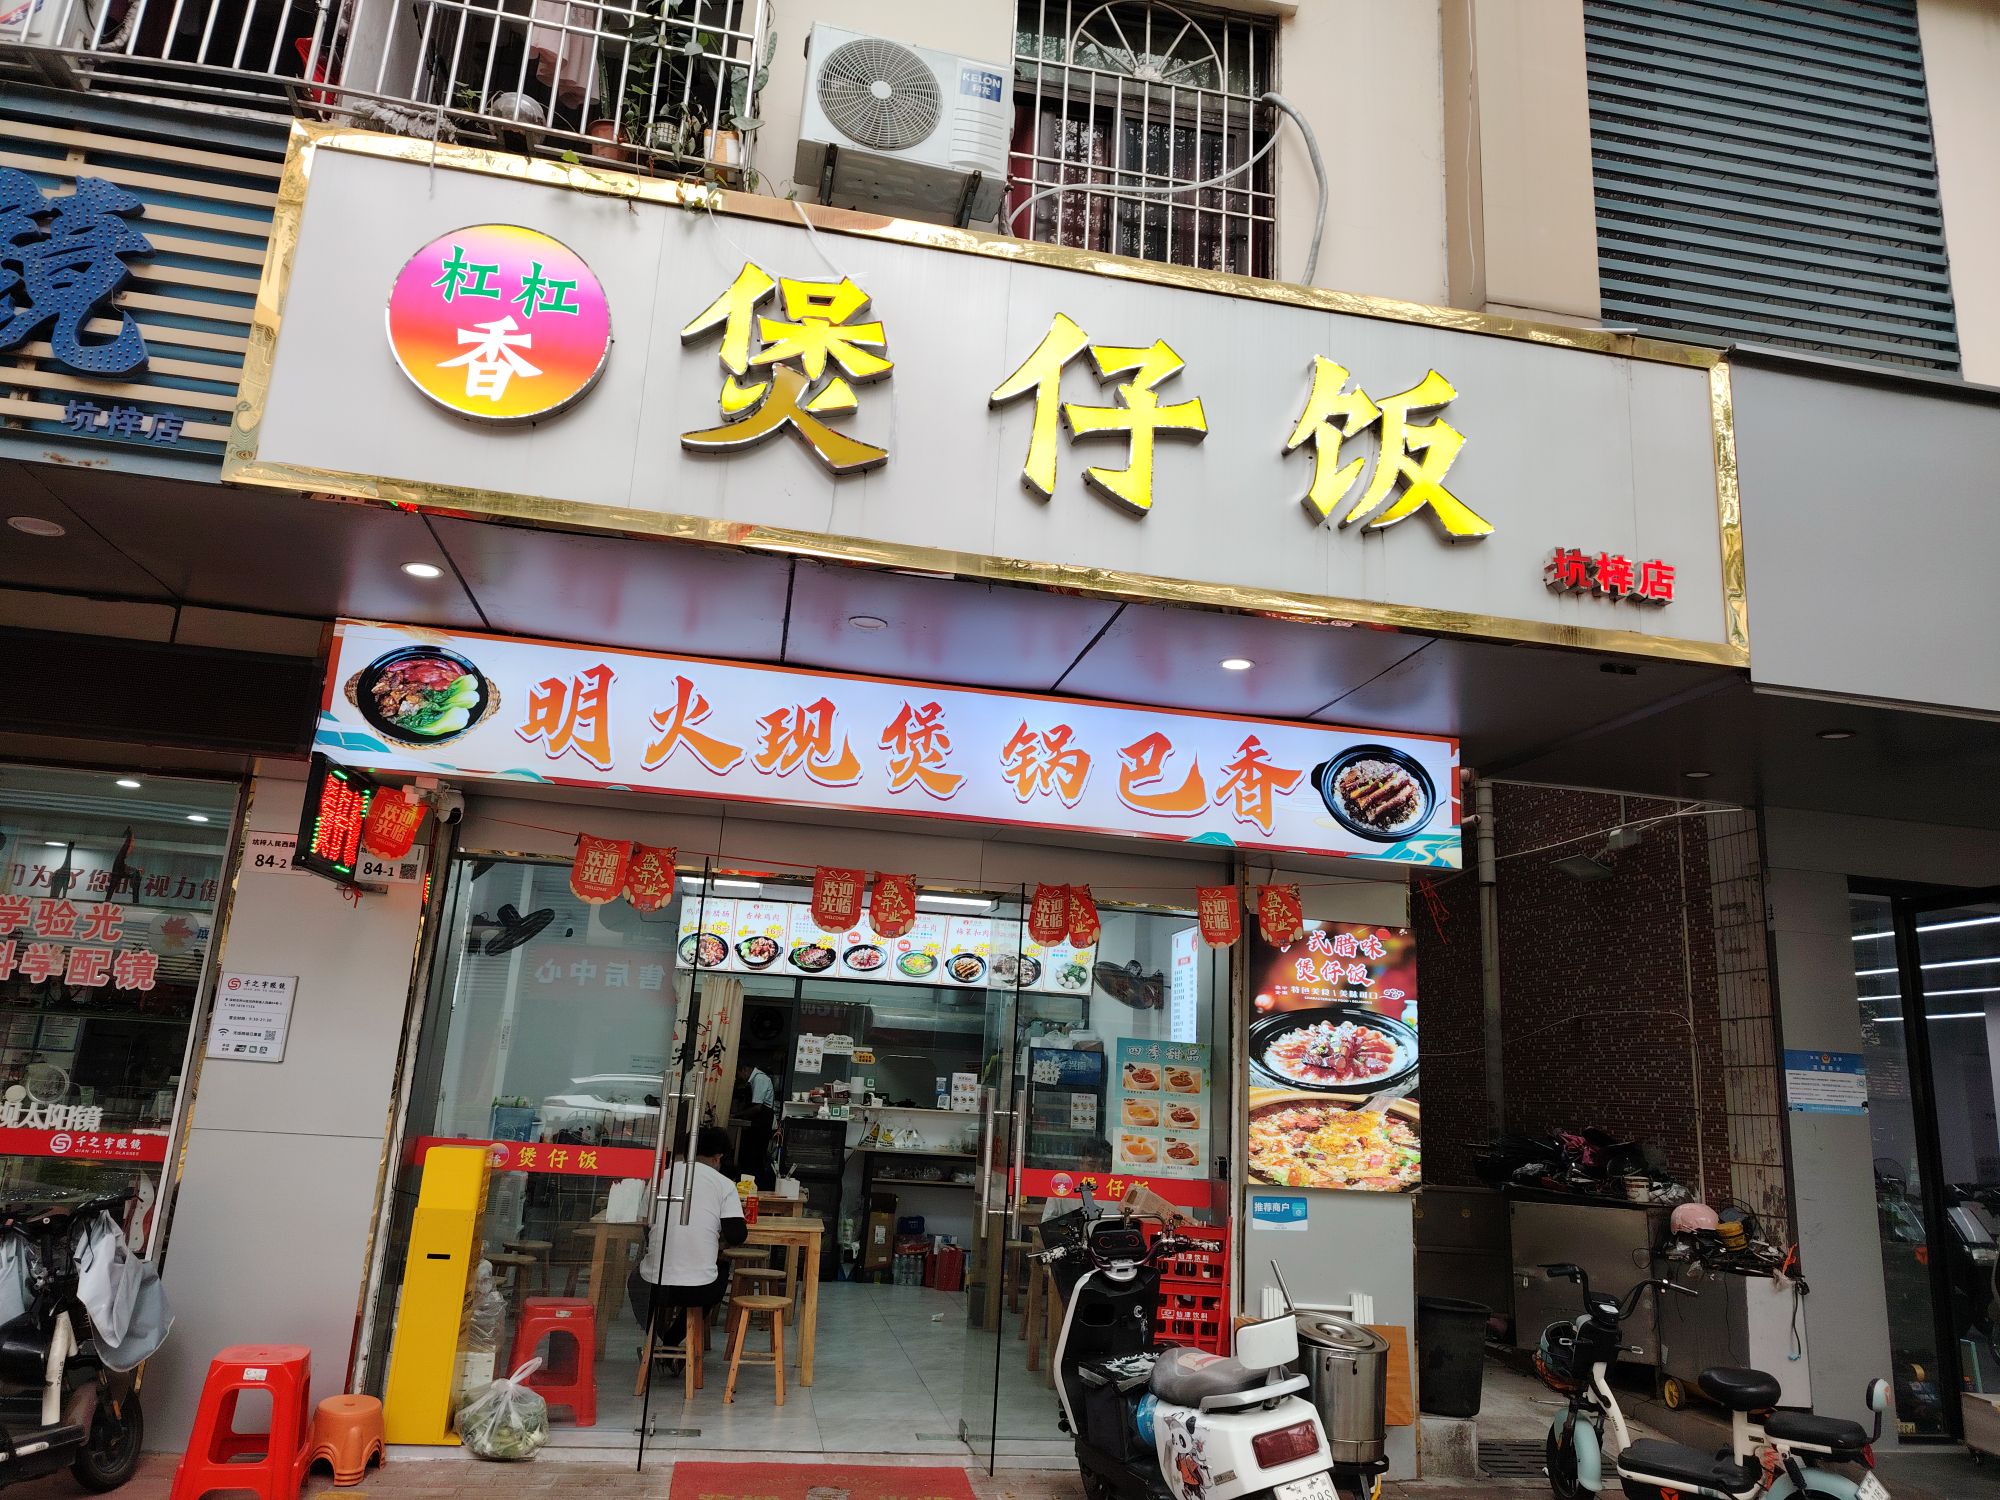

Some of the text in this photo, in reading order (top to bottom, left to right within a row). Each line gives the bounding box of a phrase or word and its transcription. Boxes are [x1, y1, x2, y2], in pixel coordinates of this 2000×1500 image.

[962, 72, 1000, 89] KELON
[431, 245, 579, 318] 杠杠
[436, 315, 543, 401] 香
[680, 262, 1496, 542] 煲仔饭
[61, 399, 184, 444] 坑梓店
[1546, 547, 1677, 605] 坑梓店
[381, 803, 417, 827] 欢迎
[374, 818, 409, 843] 光临
[254, 853, 288, 868] 84-2
[362, 862, 394, 877] 84-1
[585, 851, 619, 869] 欢迎
[581, 866, 616, 885] 光临
[822, 881, 855, 899] 欢迎
[820, 896, 852, 914] 光临
[1037, 898, 1063, 914] 欢迎
[1201, 899, 1228, 916] 欢迎
[1035, 911, 1063, 928] 光临
[1203, 912, 1230, 930] 光临
[1281, 929, 1387, 960] 式腊味
[1295, 957, 1376, 988] 煲仔饭
[1126, 1043, 1200, 1062] 四季甜品
[518, 1146, 598, 1170] 煲仔饭
[1254, 1201, 1290, 1212] 推荐商户
